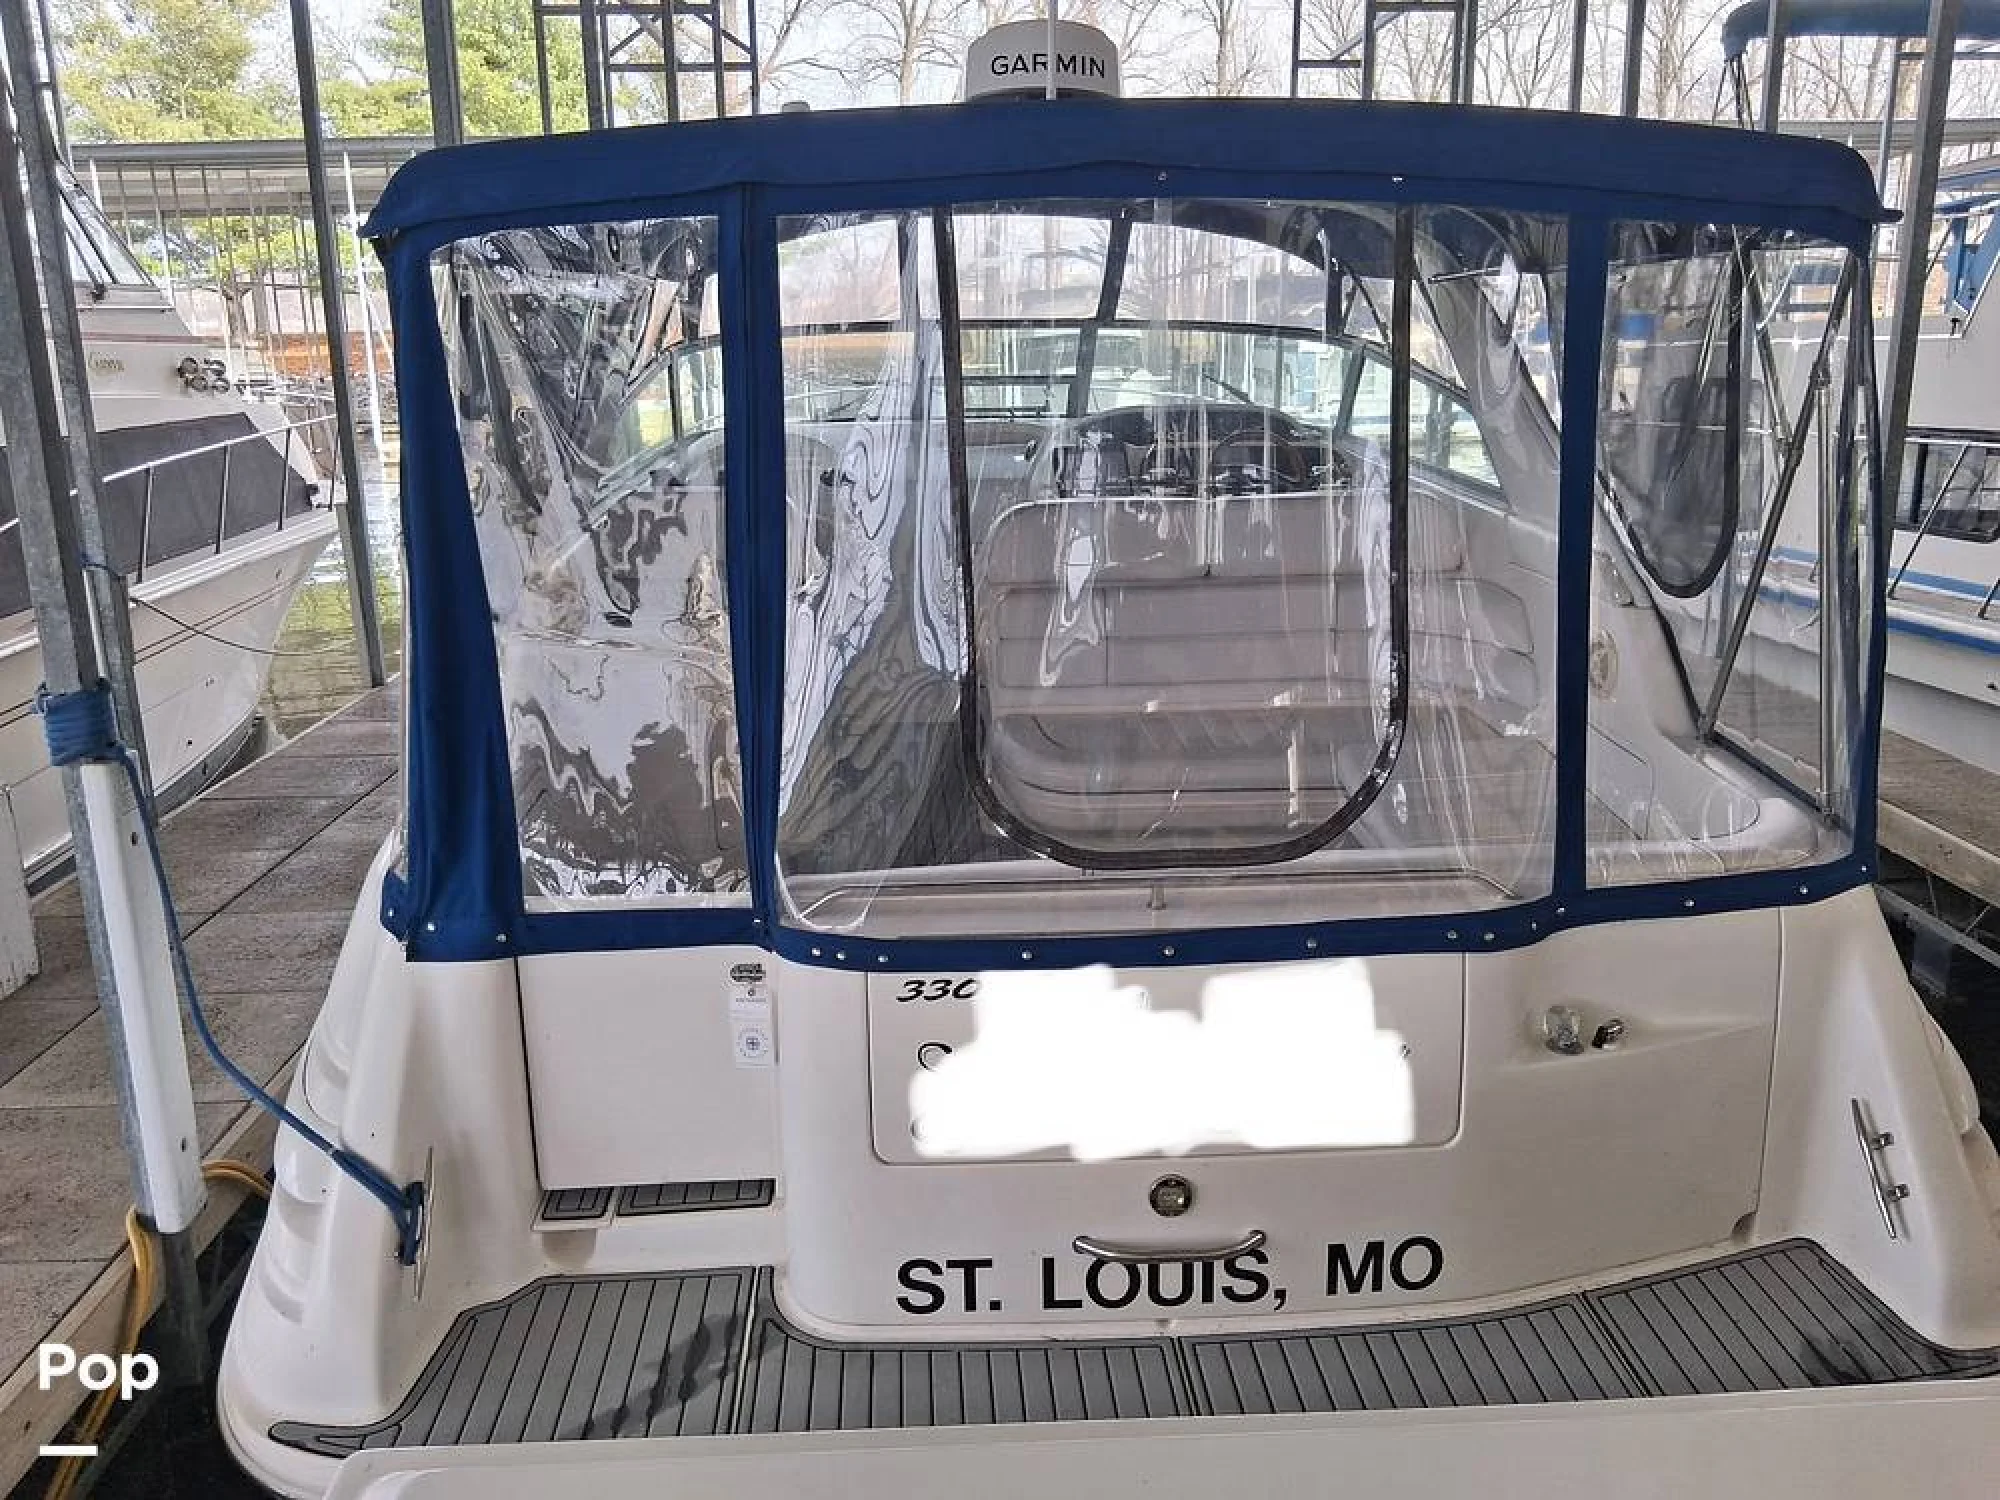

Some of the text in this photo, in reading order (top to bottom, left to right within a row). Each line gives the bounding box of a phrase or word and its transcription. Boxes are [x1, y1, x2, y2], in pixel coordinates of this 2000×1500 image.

[991, 53, 1105, 79] GARMIN
[896, 978, 977, 1002] 330
[897, 1235, 1446, 1315] ST. LOUIS, MO
